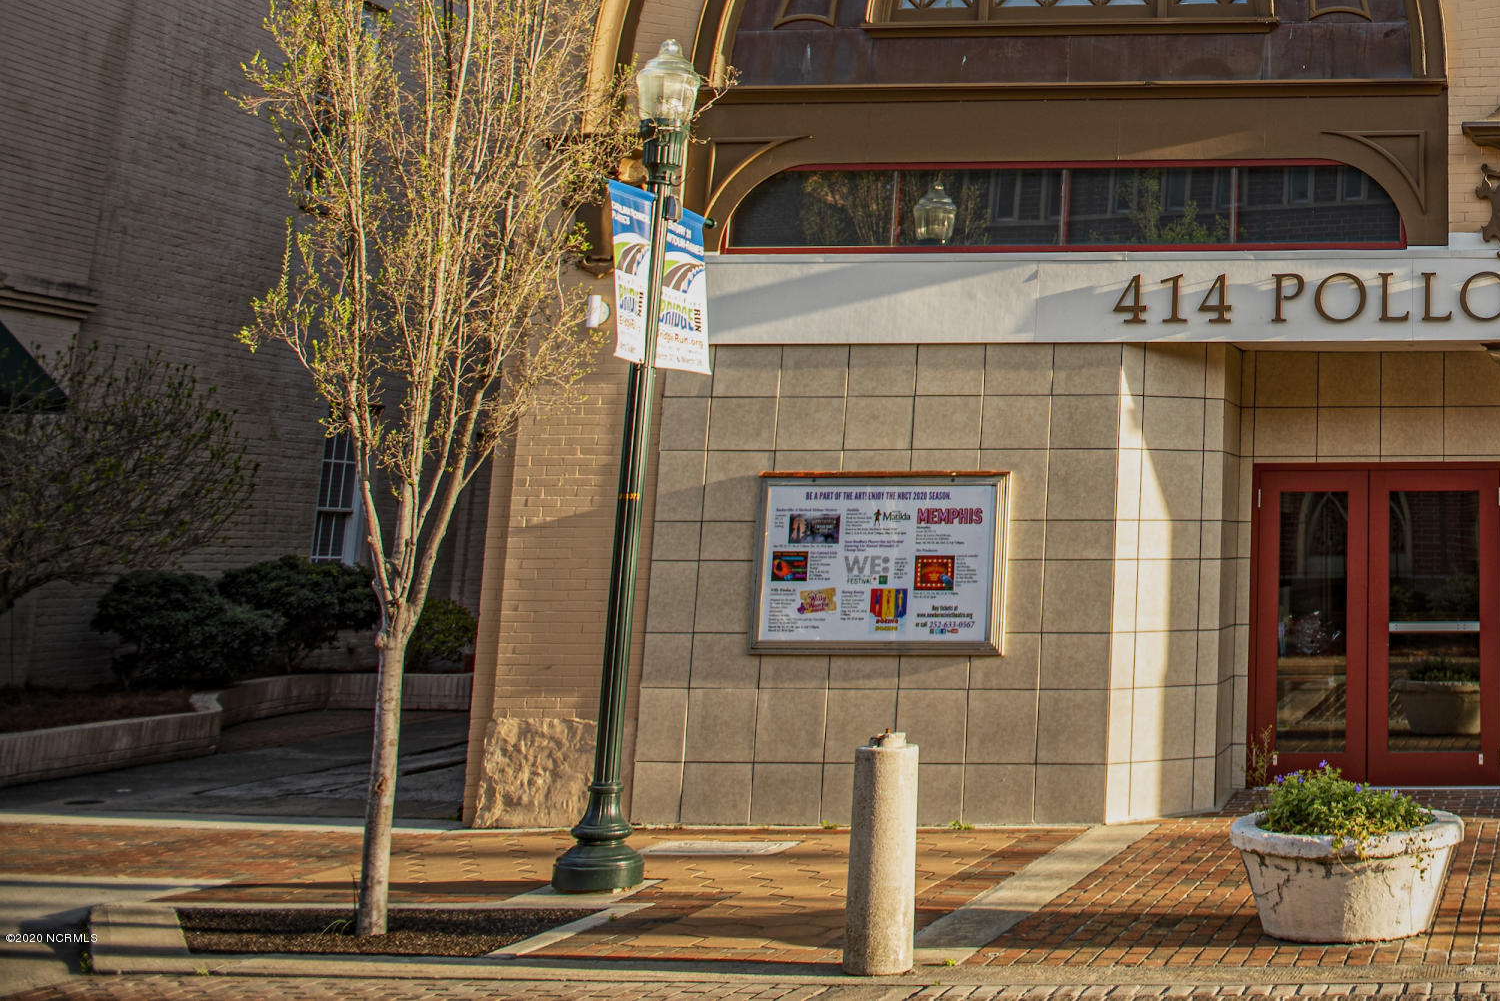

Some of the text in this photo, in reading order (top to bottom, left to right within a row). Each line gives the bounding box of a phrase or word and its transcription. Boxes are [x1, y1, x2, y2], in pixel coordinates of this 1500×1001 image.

[1112, 272, 1234, 326] 414
[806, 491, 813, 500] BE
[814, 491, 818, 500] A
[819, 491, 833, 500] PART
[834, 491, 842, 500] OF
[843, 491, 853, 500] THE
[868, 491, 884, 500] ENJOY
[886, 491, 897, 500] THE
[913, 491, 927, 500] 2020
[883, 510, 911, 522] Matilda
[917, 507, 983, 525] MEMPHIS
